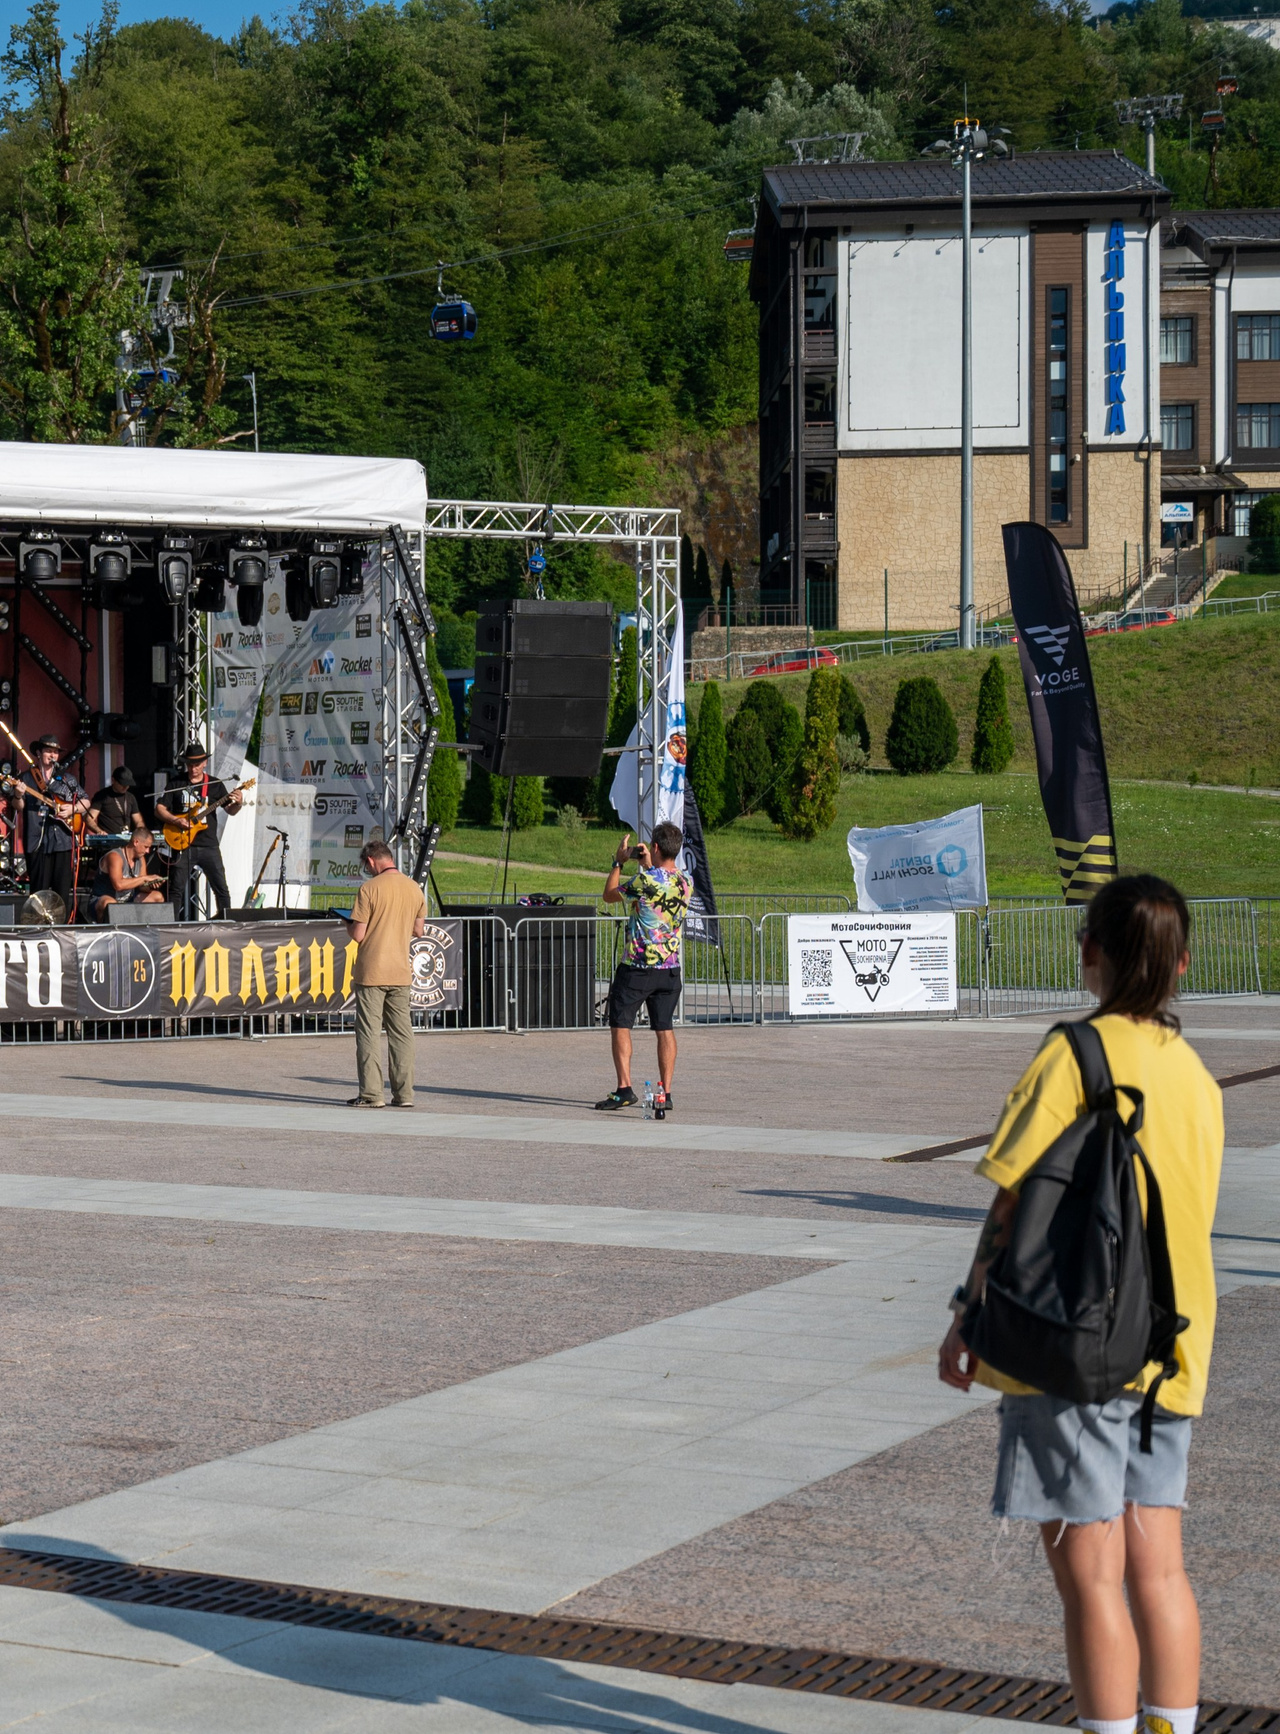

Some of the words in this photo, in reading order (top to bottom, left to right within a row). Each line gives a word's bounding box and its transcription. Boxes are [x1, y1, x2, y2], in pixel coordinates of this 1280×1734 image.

[1106, 219, 1126, 435] АЛЬПИКА
[214, 632, 233, 648] AVT
[238, 672, 253, 680] SOUTH
[1034, 667, 1080, 686] VOGE
[1049, 686, 1070, 694] Beyond
[1070, 682, 1086, 690] Quality
[336, 696, 359, 705] SOUTH
[301, 760, 327, 776] AVT
[329, 799, 352, 808] SOUTH
[831, 922, 912, 931] МотоСочиФорния
[857, 940, 887, 952] MOTO
[857, 954, 887, 964] SOCHIFORNIA
[92, 960, 105, 984] 20
[133, 960, 147, 982] 25
